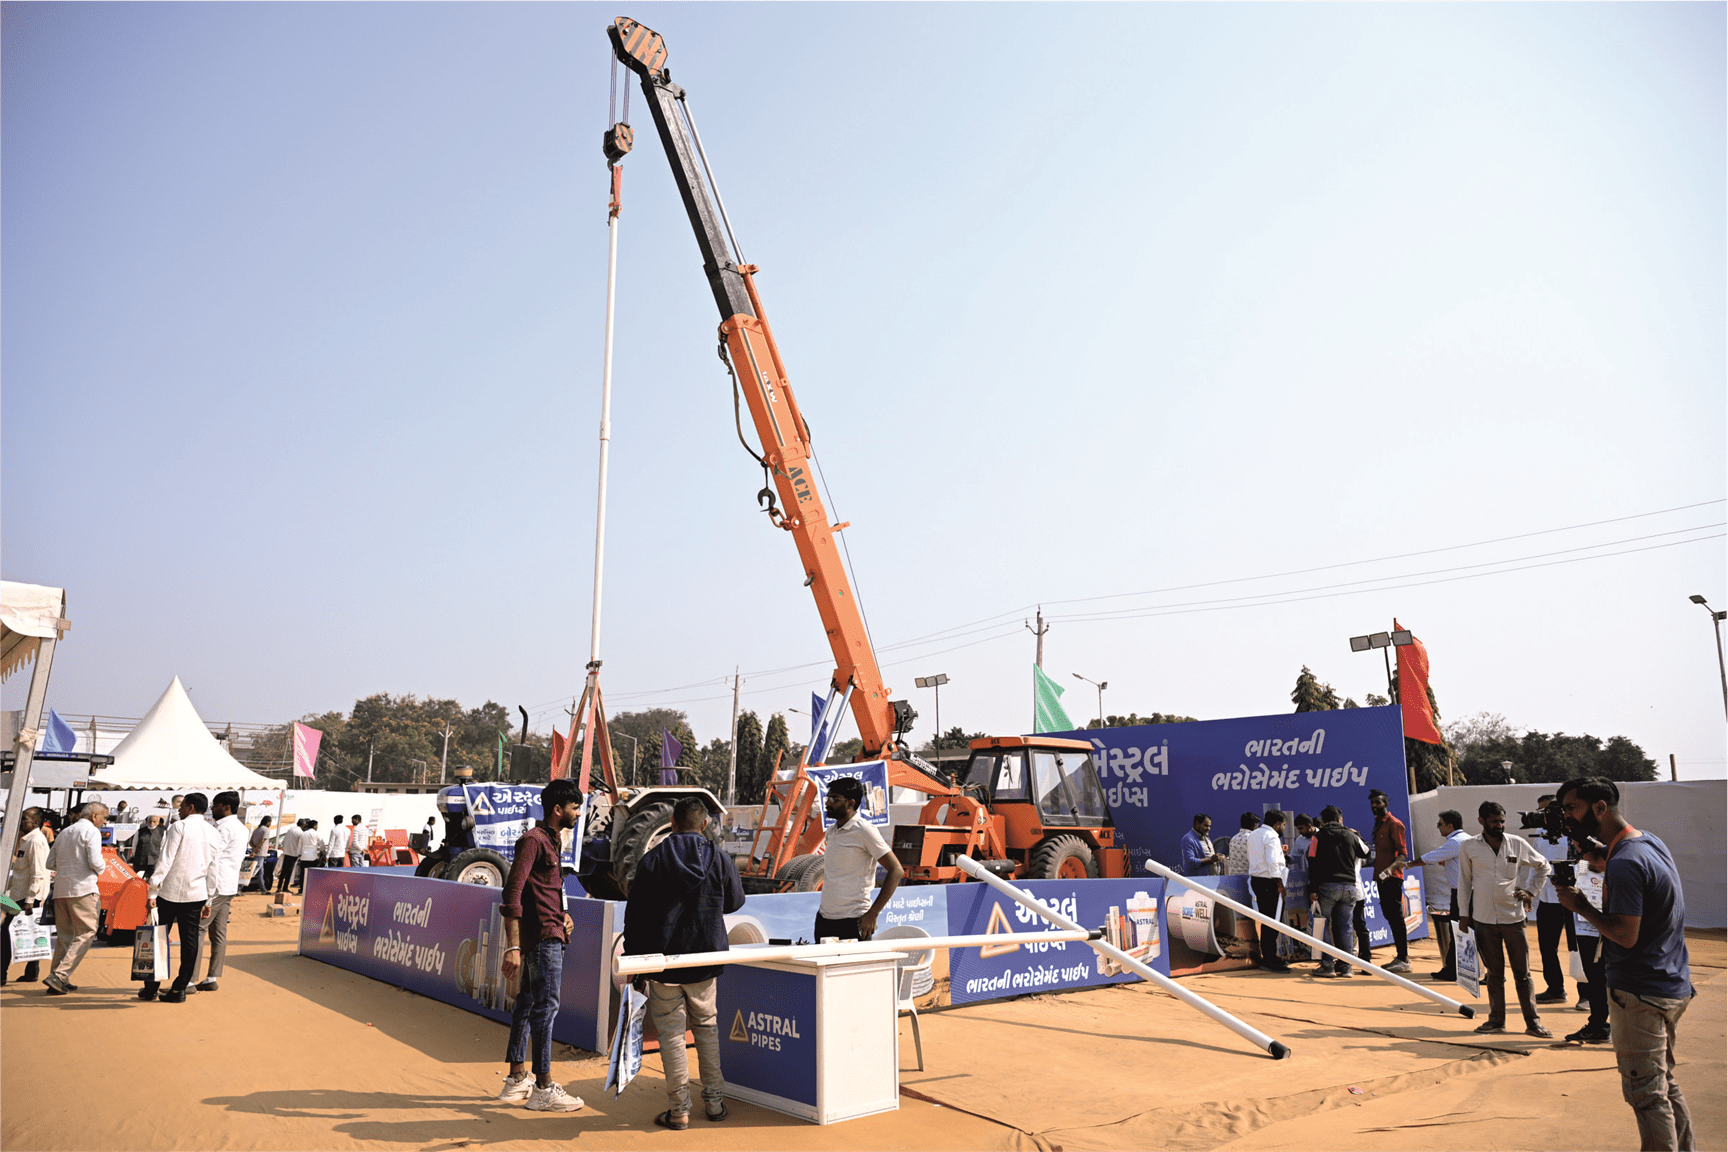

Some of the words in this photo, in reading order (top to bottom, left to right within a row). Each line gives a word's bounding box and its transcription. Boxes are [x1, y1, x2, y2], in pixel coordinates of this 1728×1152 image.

[788, 466, 812, 504] ACE
[1245, 728, 1326, 757] ભારતની
[1211, 763, 1300, 790] ભરોસેમંદ
[1305, 761, 1369, 788] પાઈપ
[497, 804, 527, 815] પાઈપ્સ
[1100, 831, 1111, 839] ACE
[393, 897, 432, 928] ભારતની
[1136, 918, 1155, 926] ASTRAL
[373, 928, 415, 967] ભરોસેમંદ
[415, 942, 446, 976] પાઈપ
[966, 969, 1012, 994] ભારતની
[1012, 965, 1060, 988] ભરોસેમંદ
[1060, 962, 1090, 982] પાઈપ
[747, 1011, 801, 1039] ASTRAL
[751, 1032, 782, 1052] PIPES
